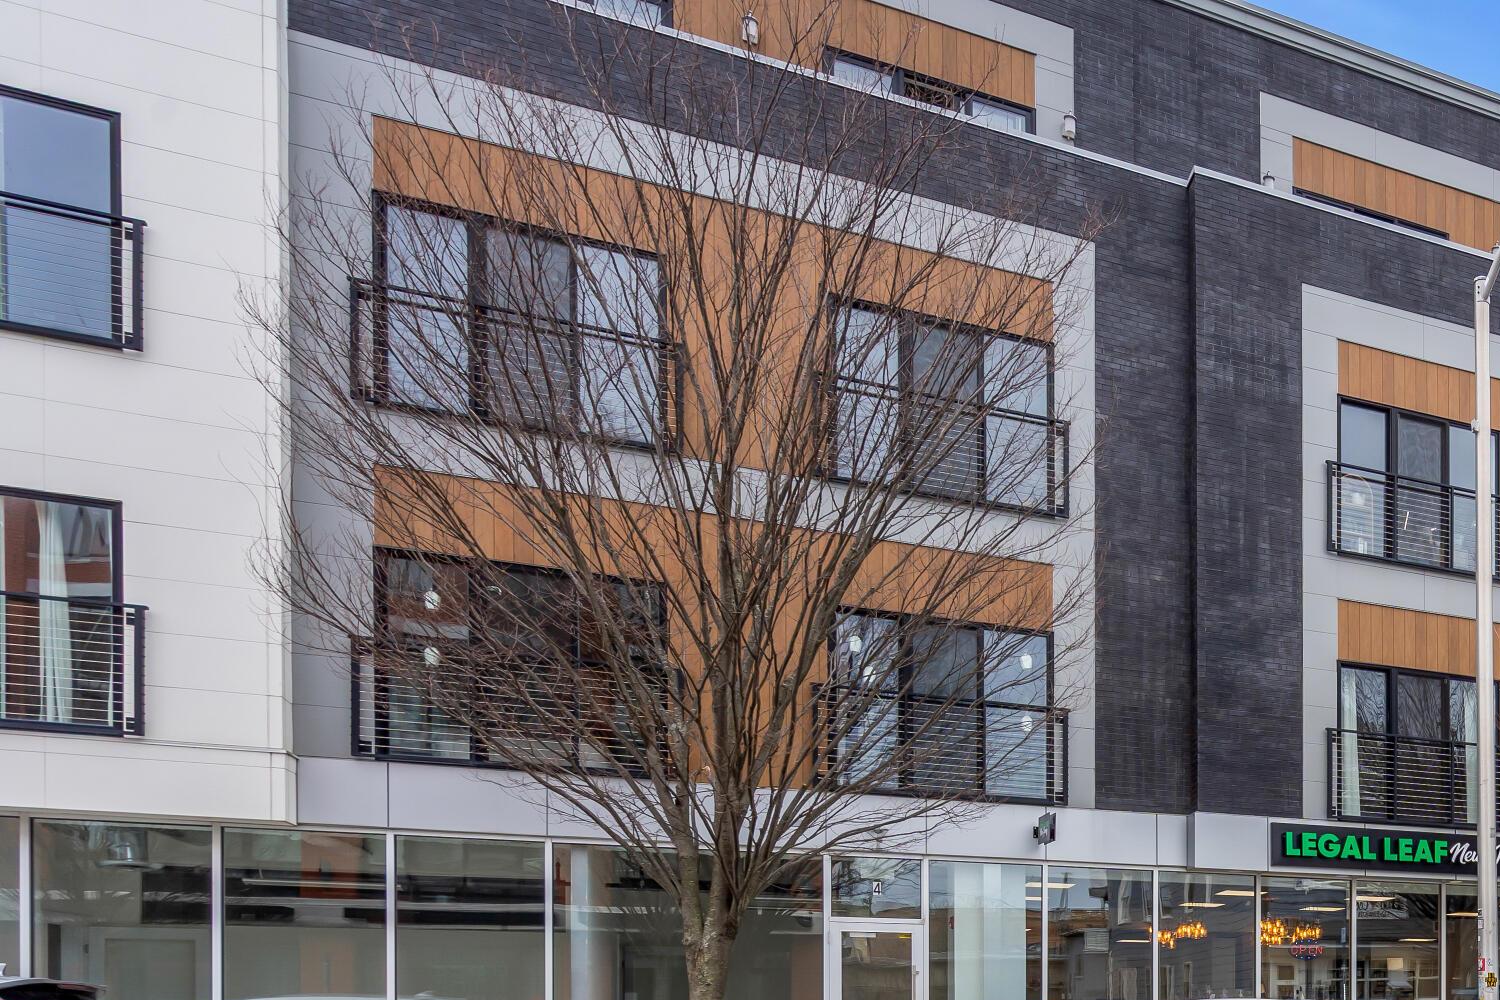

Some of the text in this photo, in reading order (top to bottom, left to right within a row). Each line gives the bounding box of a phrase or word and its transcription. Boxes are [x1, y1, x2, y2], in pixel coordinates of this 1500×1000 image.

[1285, 831, 1376, 859] LEGAL
[1383, 836, 1448, 864] LEAF
[873, 882, 881, 895] 4
[1291, 945, 1324, 955] OPEN
